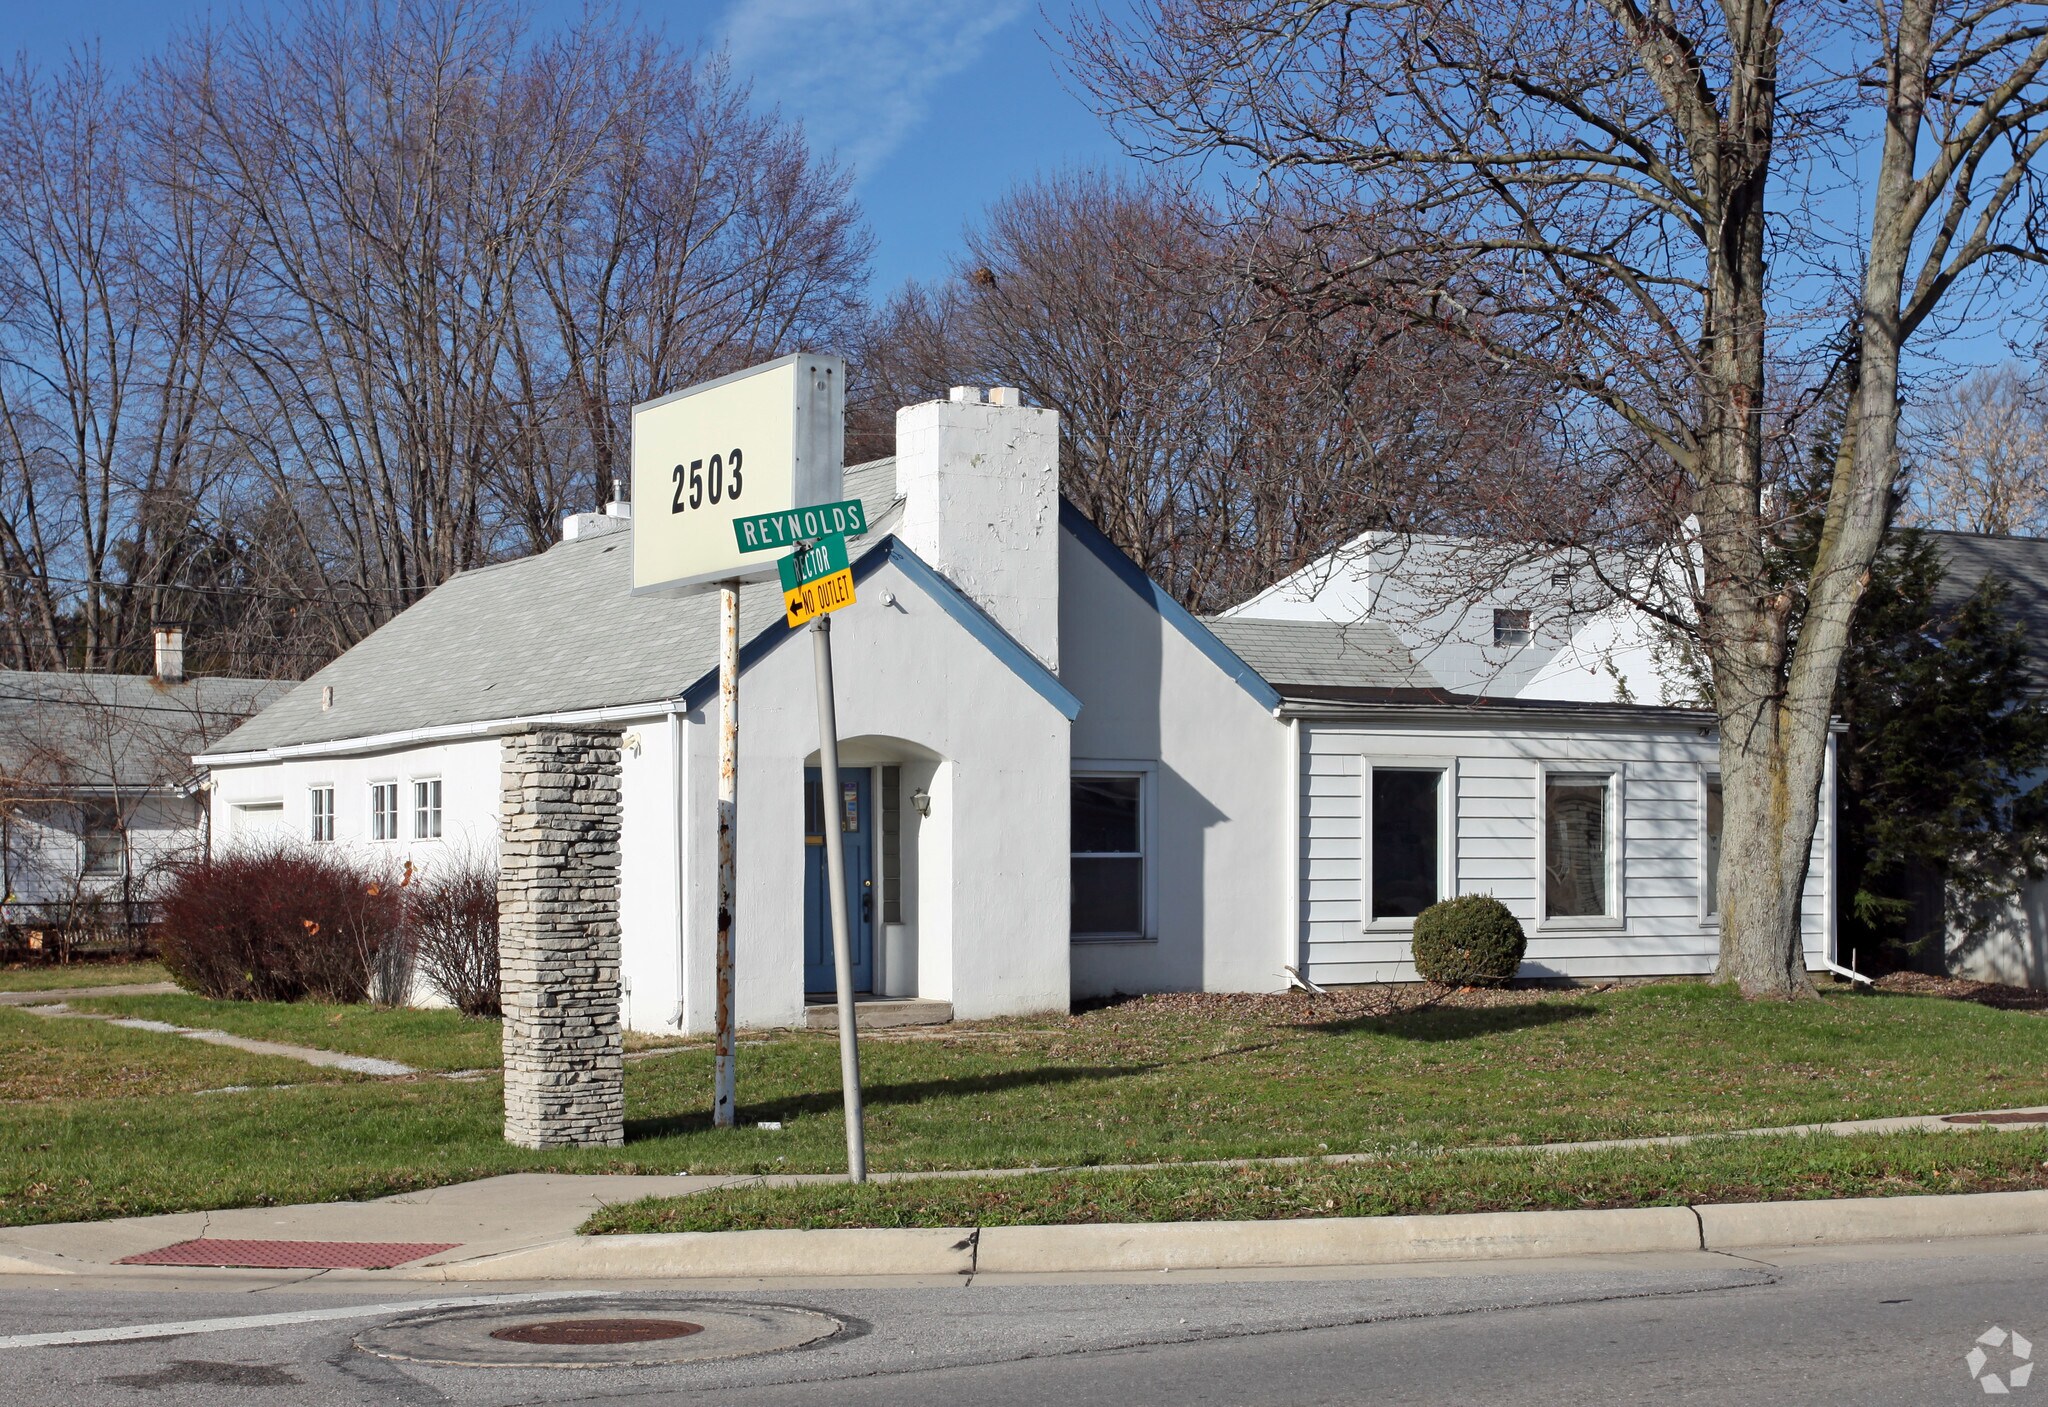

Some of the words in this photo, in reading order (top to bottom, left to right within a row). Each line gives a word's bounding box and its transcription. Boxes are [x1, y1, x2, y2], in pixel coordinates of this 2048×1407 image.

[672, 448, 743, 515] 2503
[743, 505, 861, 546] REYNOLDS
[793, 545, 831, 582] RECTOR
[802, 589, 815, 615] NO
[818, 574, 849, 609] OUTLET
